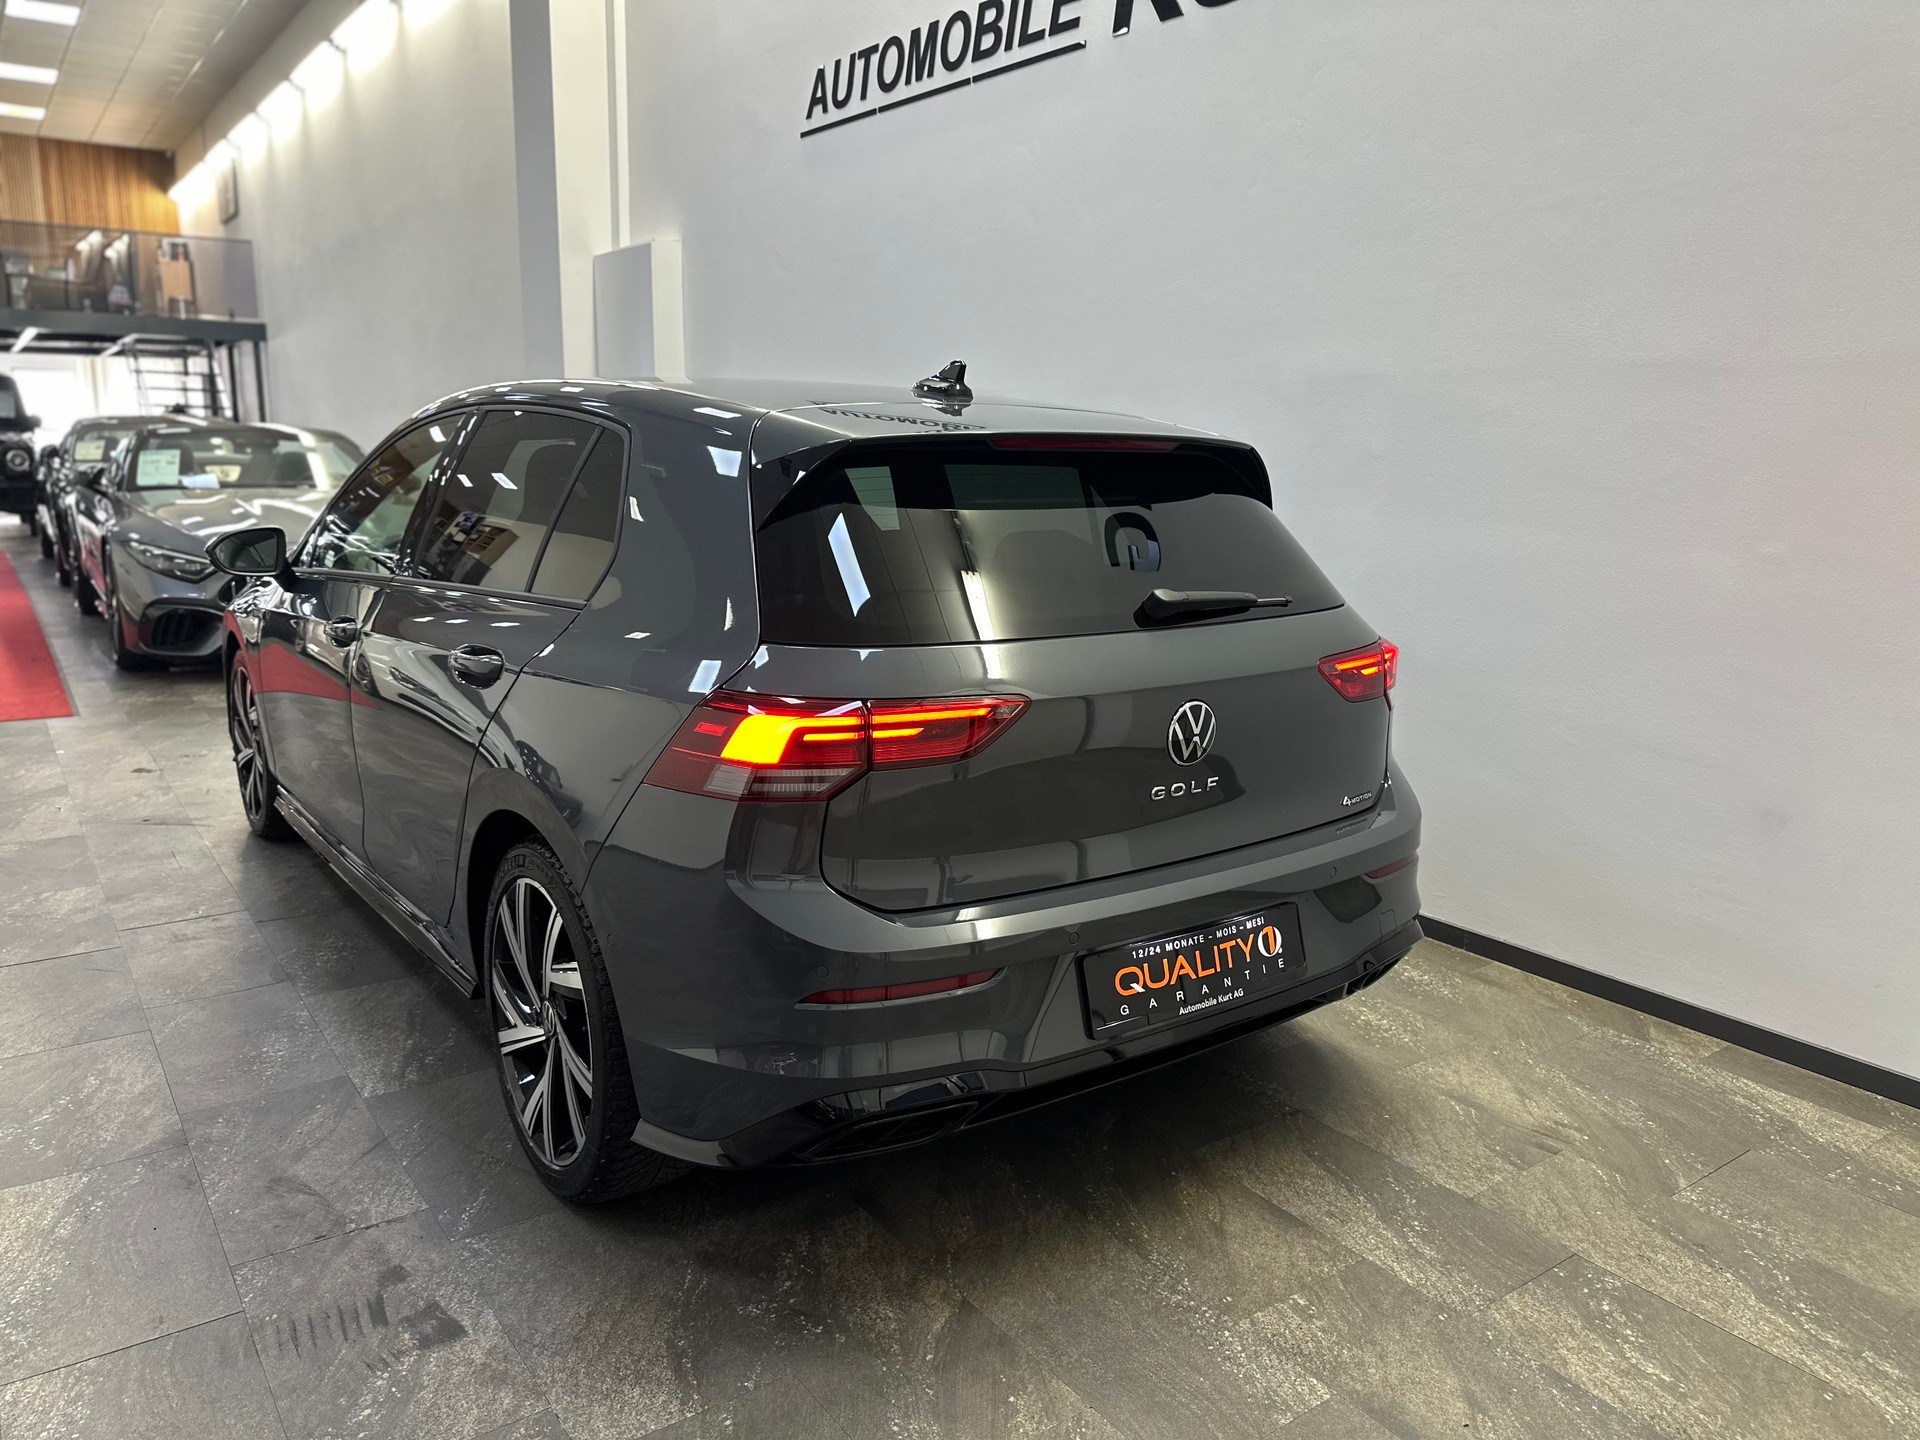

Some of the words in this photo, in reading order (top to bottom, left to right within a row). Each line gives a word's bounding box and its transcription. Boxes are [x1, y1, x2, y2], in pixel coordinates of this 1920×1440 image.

[806, 0, 1082, 120] AUTOMOBILE
[1150, 776, 1220, 800] GOLF
[1131, 945, 1161, 959] 12/24
[1165, 934, 1205, 952] MONATE
[1216, 925, 1237, 939] MOIS
[1246, 916, 1265, 930] MESI
[1114, 933, 1255, 996] QUALITY
[1120, 958, 1285, 1016] GARANTIE
[1179, 997, 1217, 1016] Automobile
[1218, 992, 1233, 1004] Kurt
[1233, 988, 1244, 999] AG
